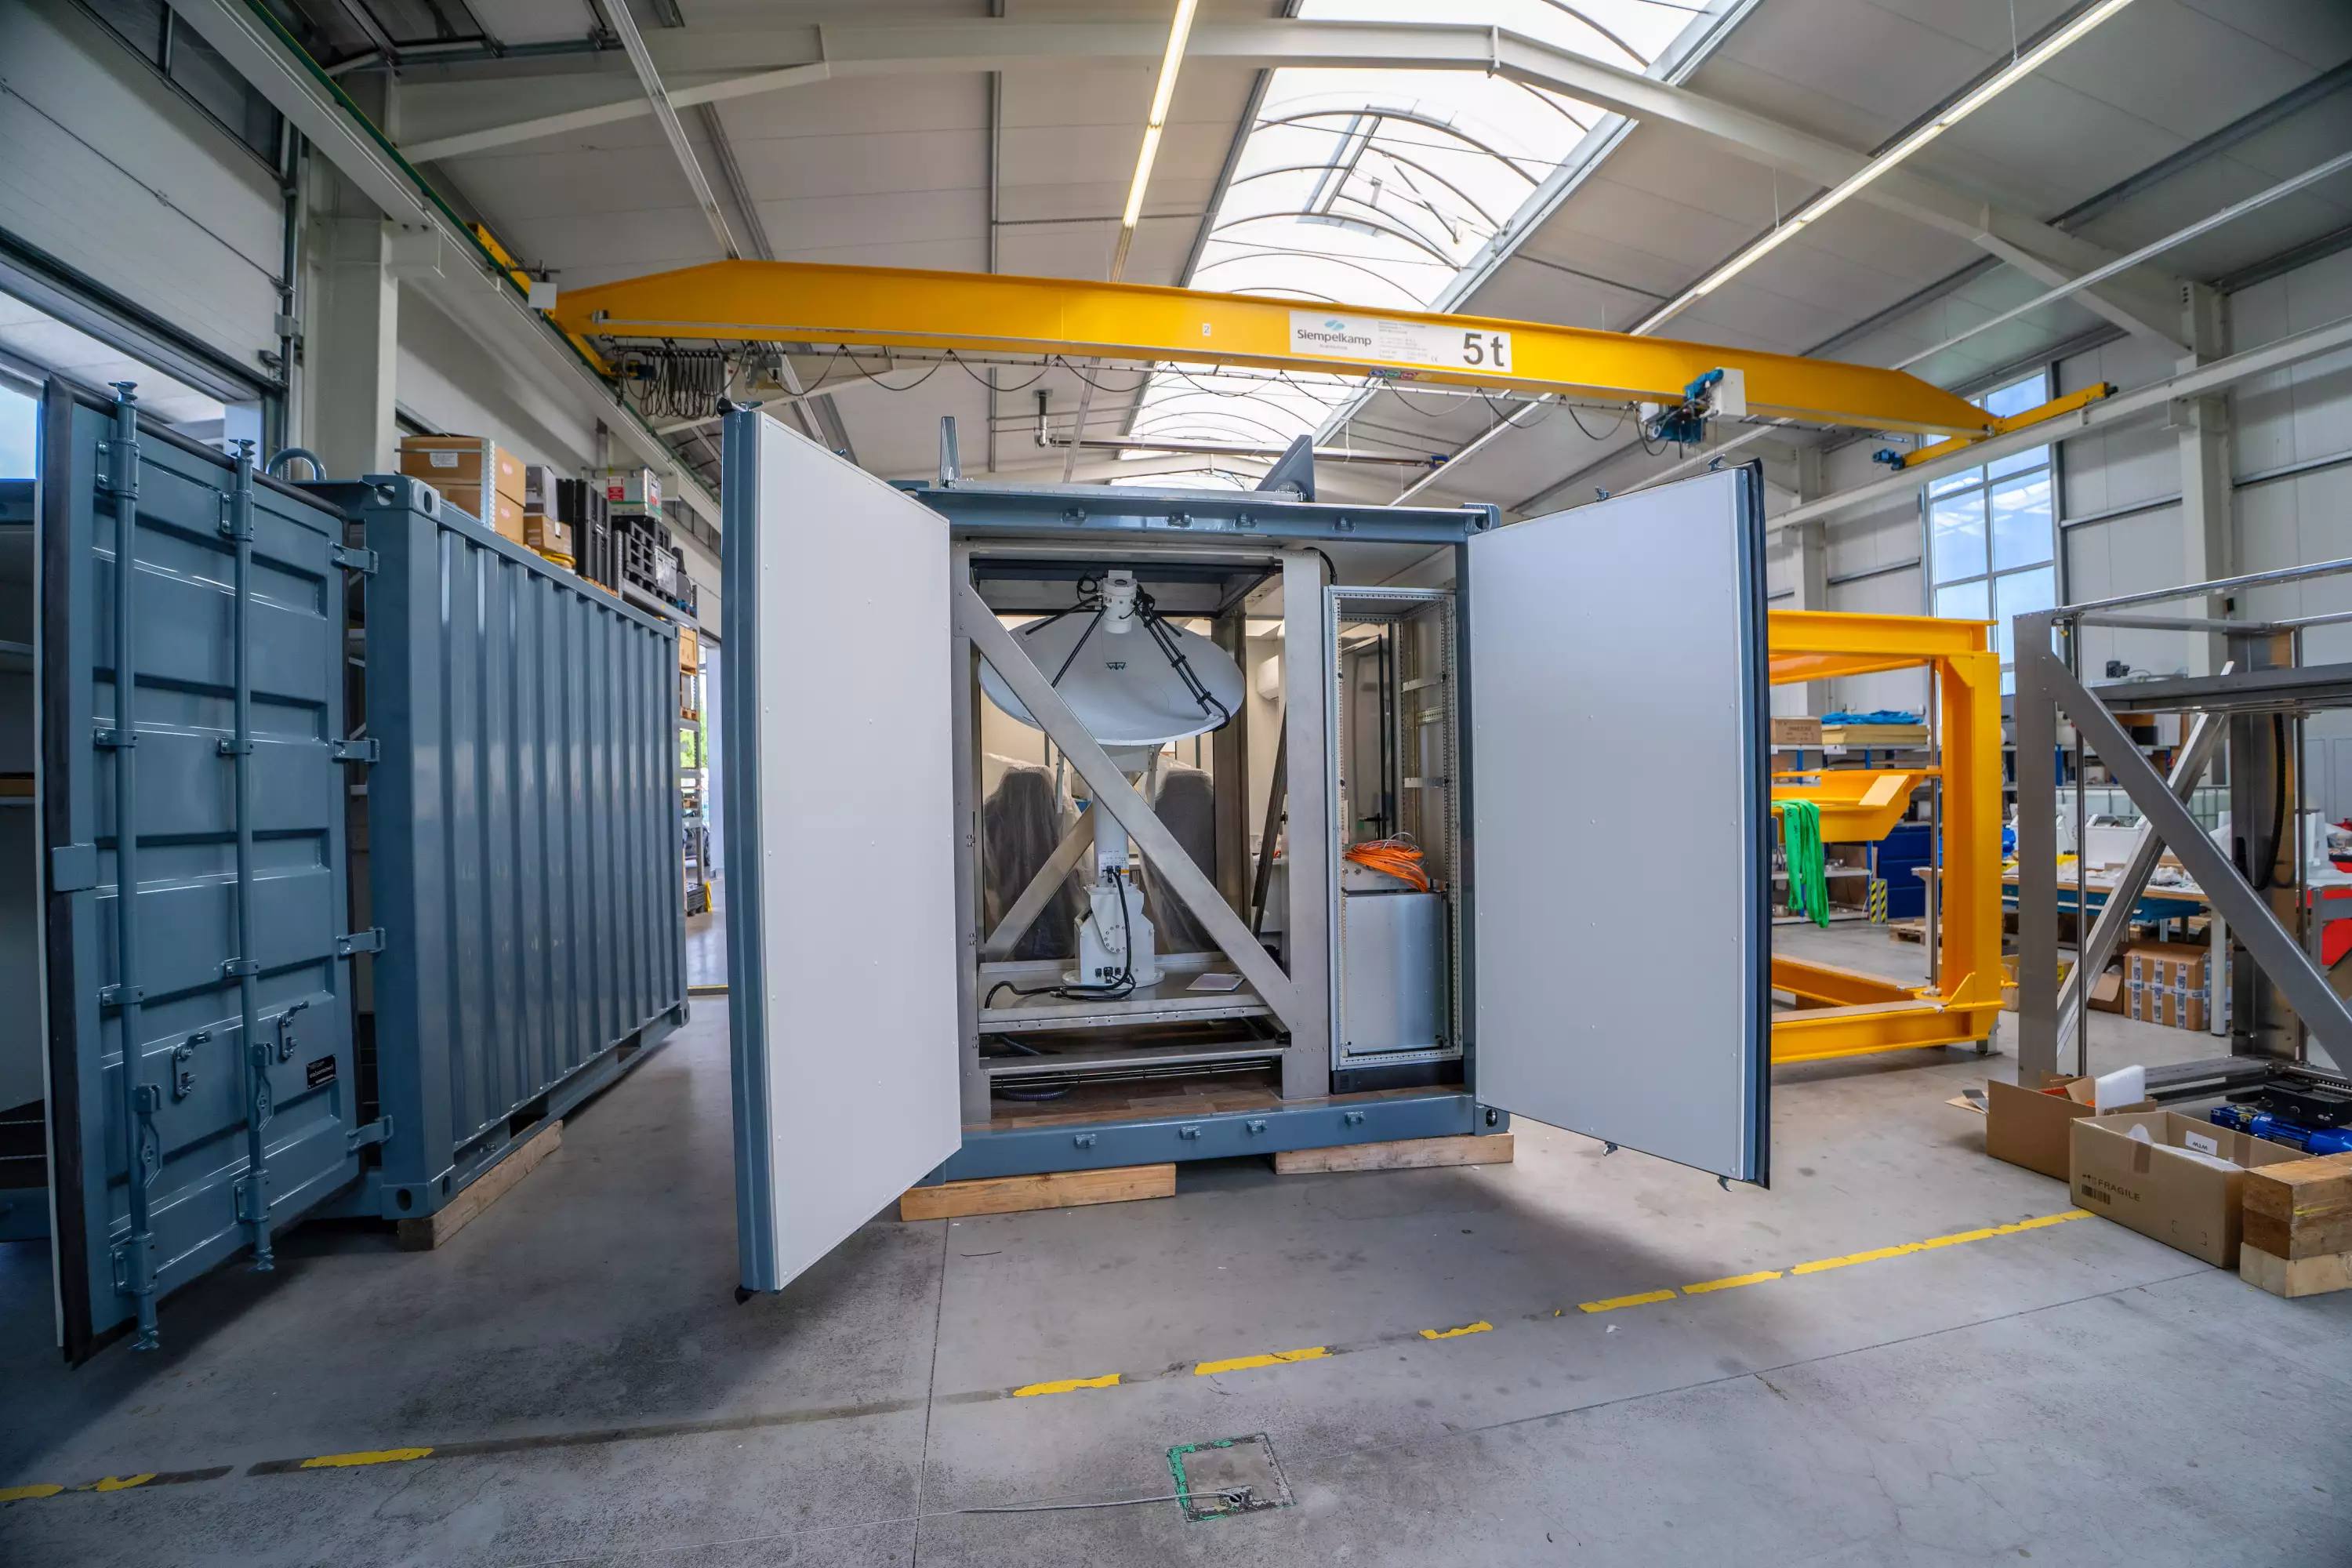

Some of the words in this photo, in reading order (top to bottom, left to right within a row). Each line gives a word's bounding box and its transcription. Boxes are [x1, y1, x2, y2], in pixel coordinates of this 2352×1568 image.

[1297, 329, 1372, 347] Siempelkamp
[1463, 332, 1483, 365] 5
[1490, 336, 1504, 367] t
[2097, 1178, 2141, 1202] FRAGILE
